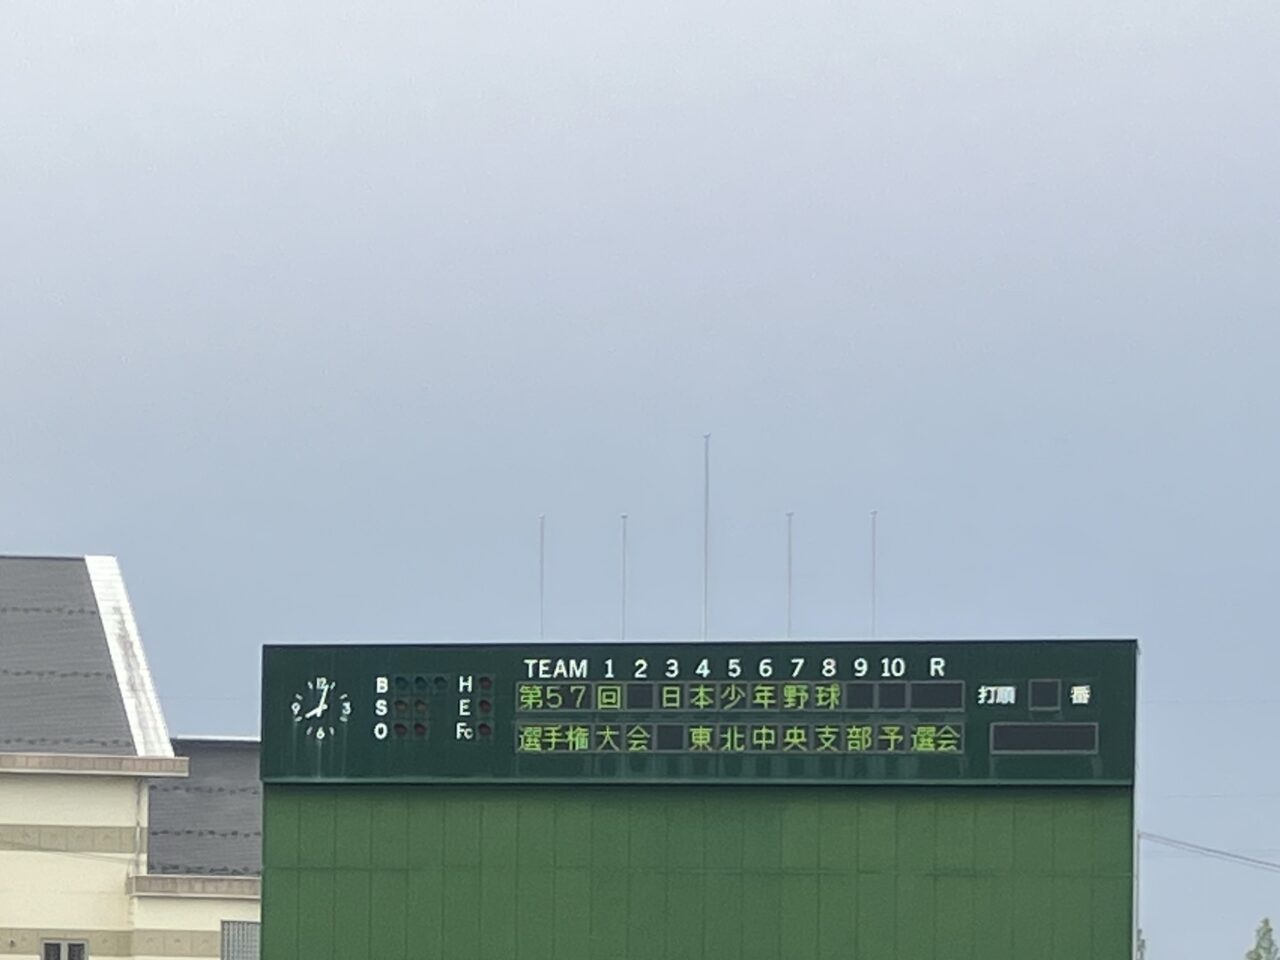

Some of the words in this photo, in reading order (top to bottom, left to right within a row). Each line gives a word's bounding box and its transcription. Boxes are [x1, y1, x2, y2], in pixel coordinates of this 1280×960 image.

[524, 659, 588, 678] TEAM
[604, 660, 614, 678] 1
[634, 660, 648, 678] 2
[665, 659, 679, 678] 3
[695, 659, 710, 678] 4
[728, 659, 741, 677] 5
[759, 659, 773, 677] 6
[791, 659, 804, 677] 7
[822, 658, 836, 677] 8
[854, 658, 868, 677] 9
[881, 658, 905, 677] 10
[930, 658, 945, 676] R
[376, 677, 388, 693] B
[459, 676, 472, 693] H
[519, 685, 621, 710] 第57回
[662, 684, 841, 710] 日本少年野球
[291, 702, 301, 715] 9
[342, 702, 351, 715] 3
[375, 699, 388, 716] S
[459, 699, 471, 716] E
[316, 726, 325, 739] 6
[519, 726, 651, 752] 選手権大会
[689, 725, 961, 752] 東北中央支部予選会
